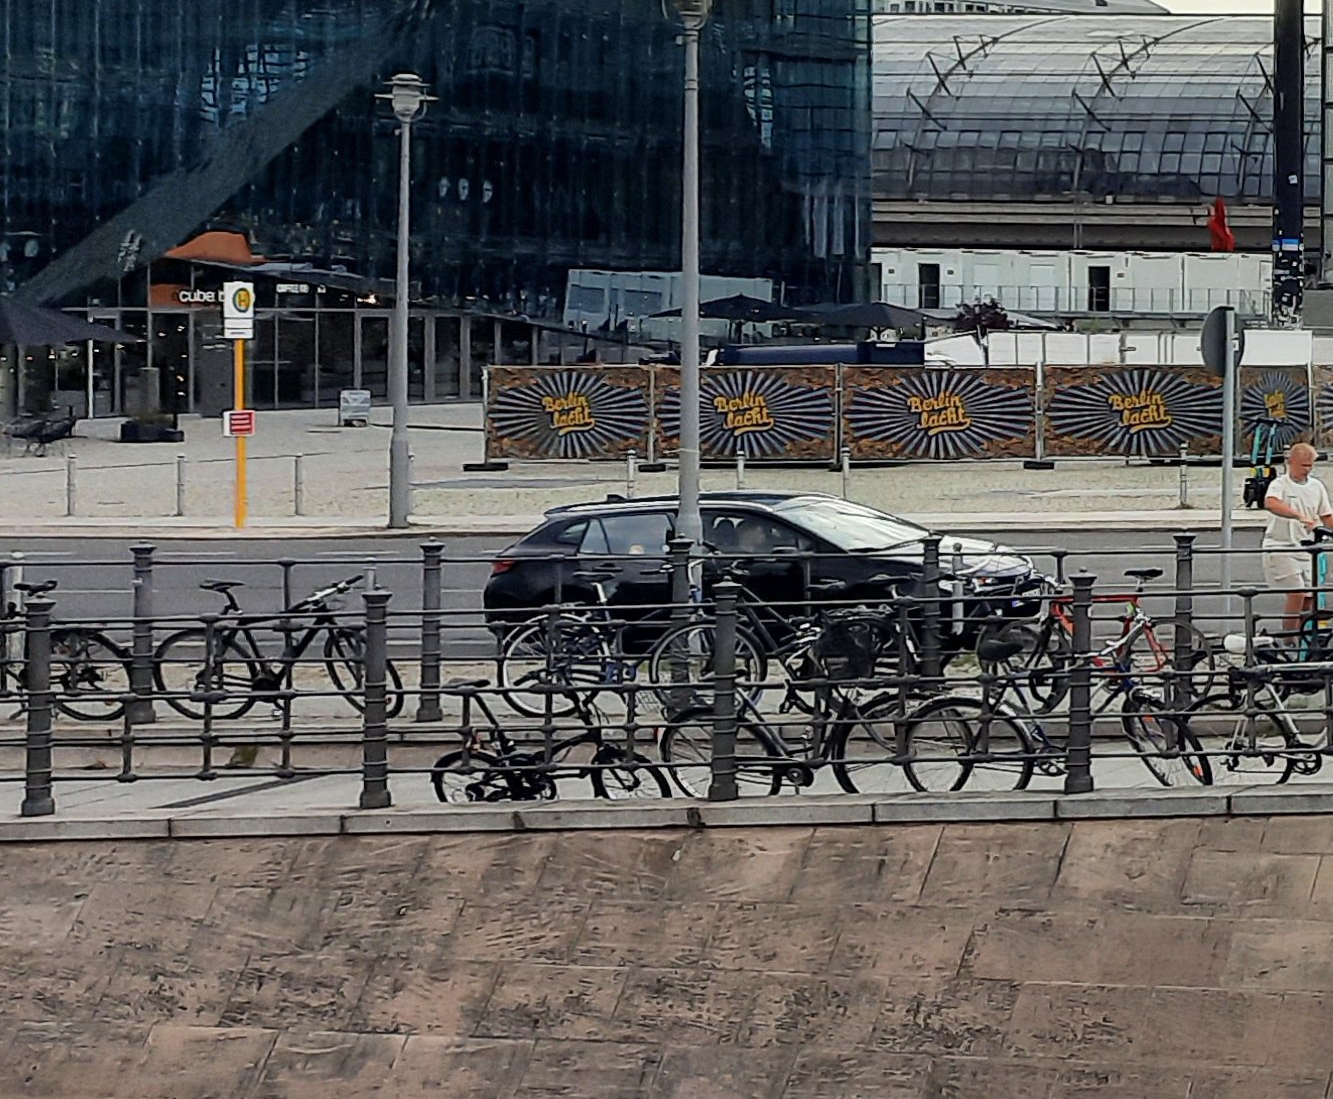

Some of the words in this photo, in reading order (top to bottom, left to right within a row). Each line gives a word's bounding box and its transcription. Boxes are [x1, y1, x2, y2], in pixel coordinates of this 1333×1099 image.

[542, 391, 588, 412] Berlin
[713, 391, 767, 413] Berlin
[907, 391, 962, 413] Berlin
[1108, 389, 1164, 411] Berlin
[550, 407, 595, 436] lacht
[723, 407, 774, 436] lacht
[916, 407, 971, 436] lacht
[1118, 405, 1171, 434] lacht
